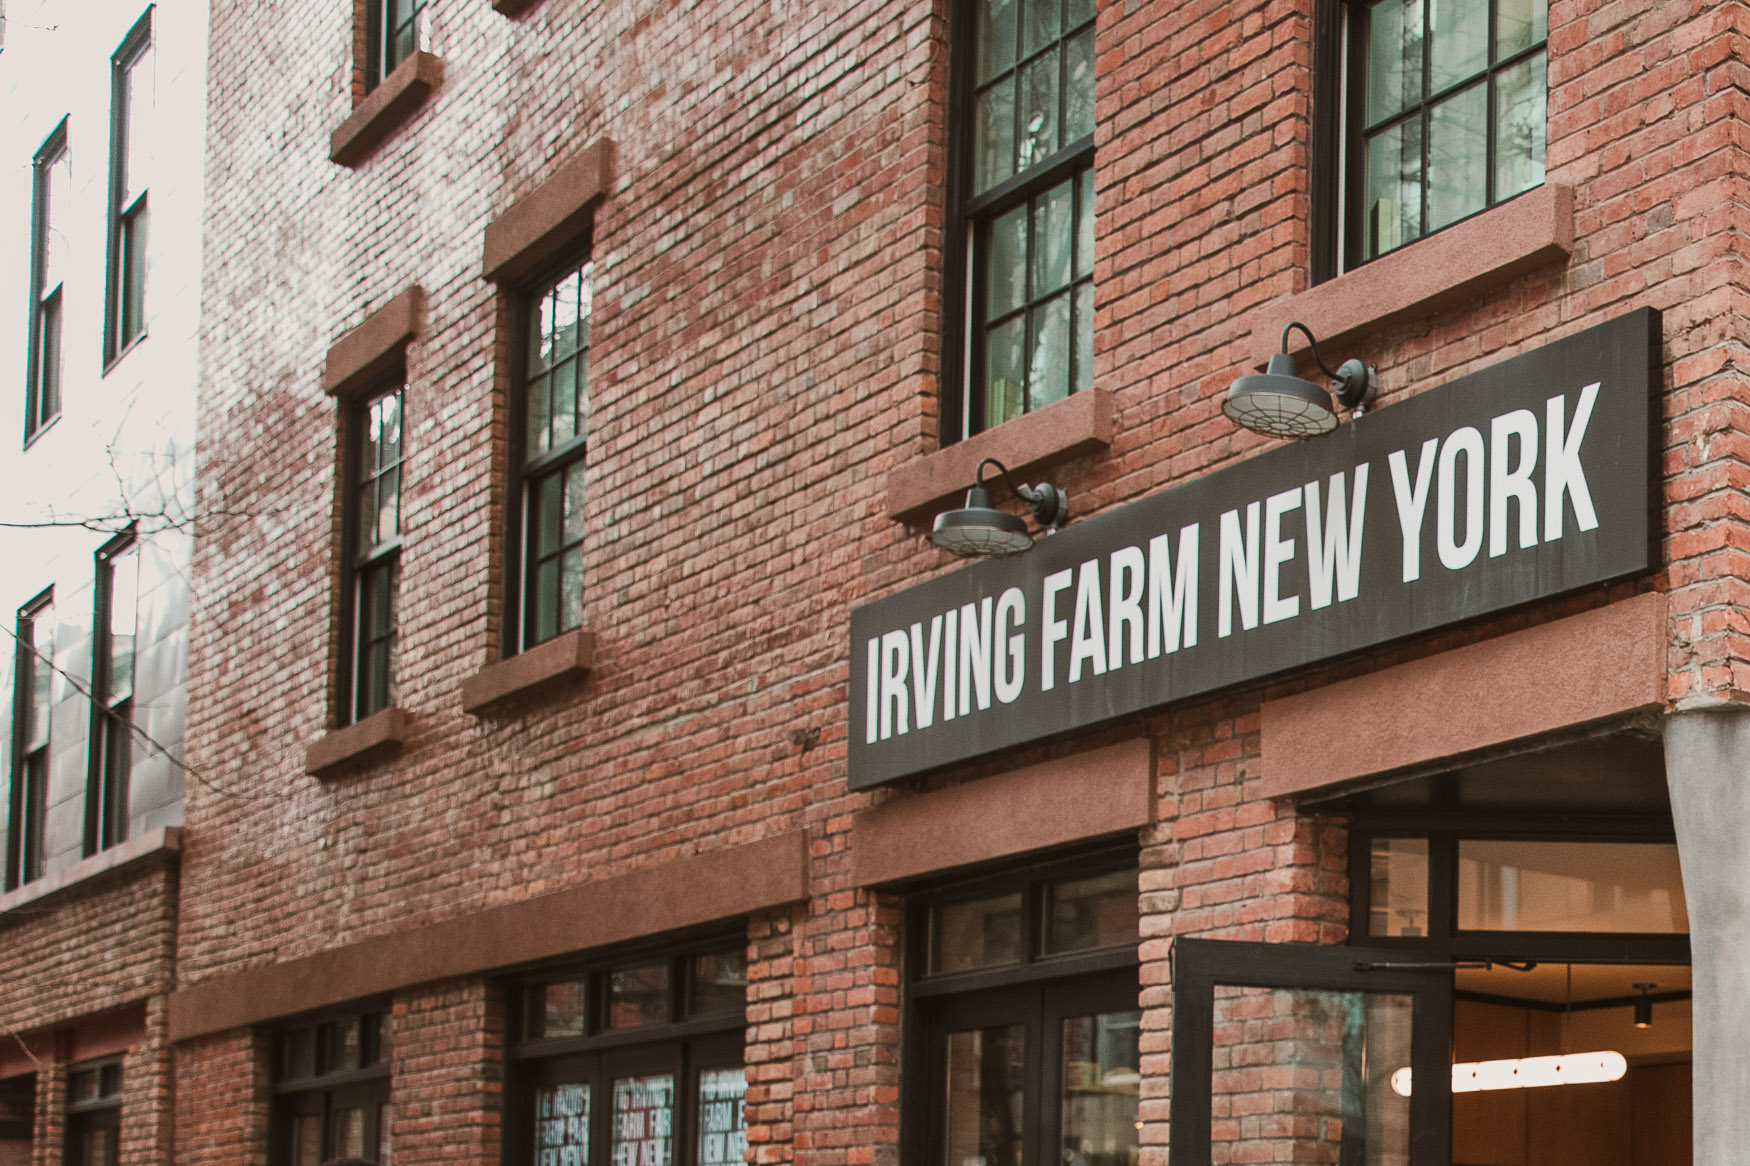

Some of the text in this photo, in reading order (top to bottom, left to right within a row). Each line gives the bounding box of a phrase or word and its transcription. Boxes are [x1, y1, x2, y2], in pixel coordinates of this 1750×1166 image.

[865, 381, 1601, 744] IRVING FARM NEW YORK
